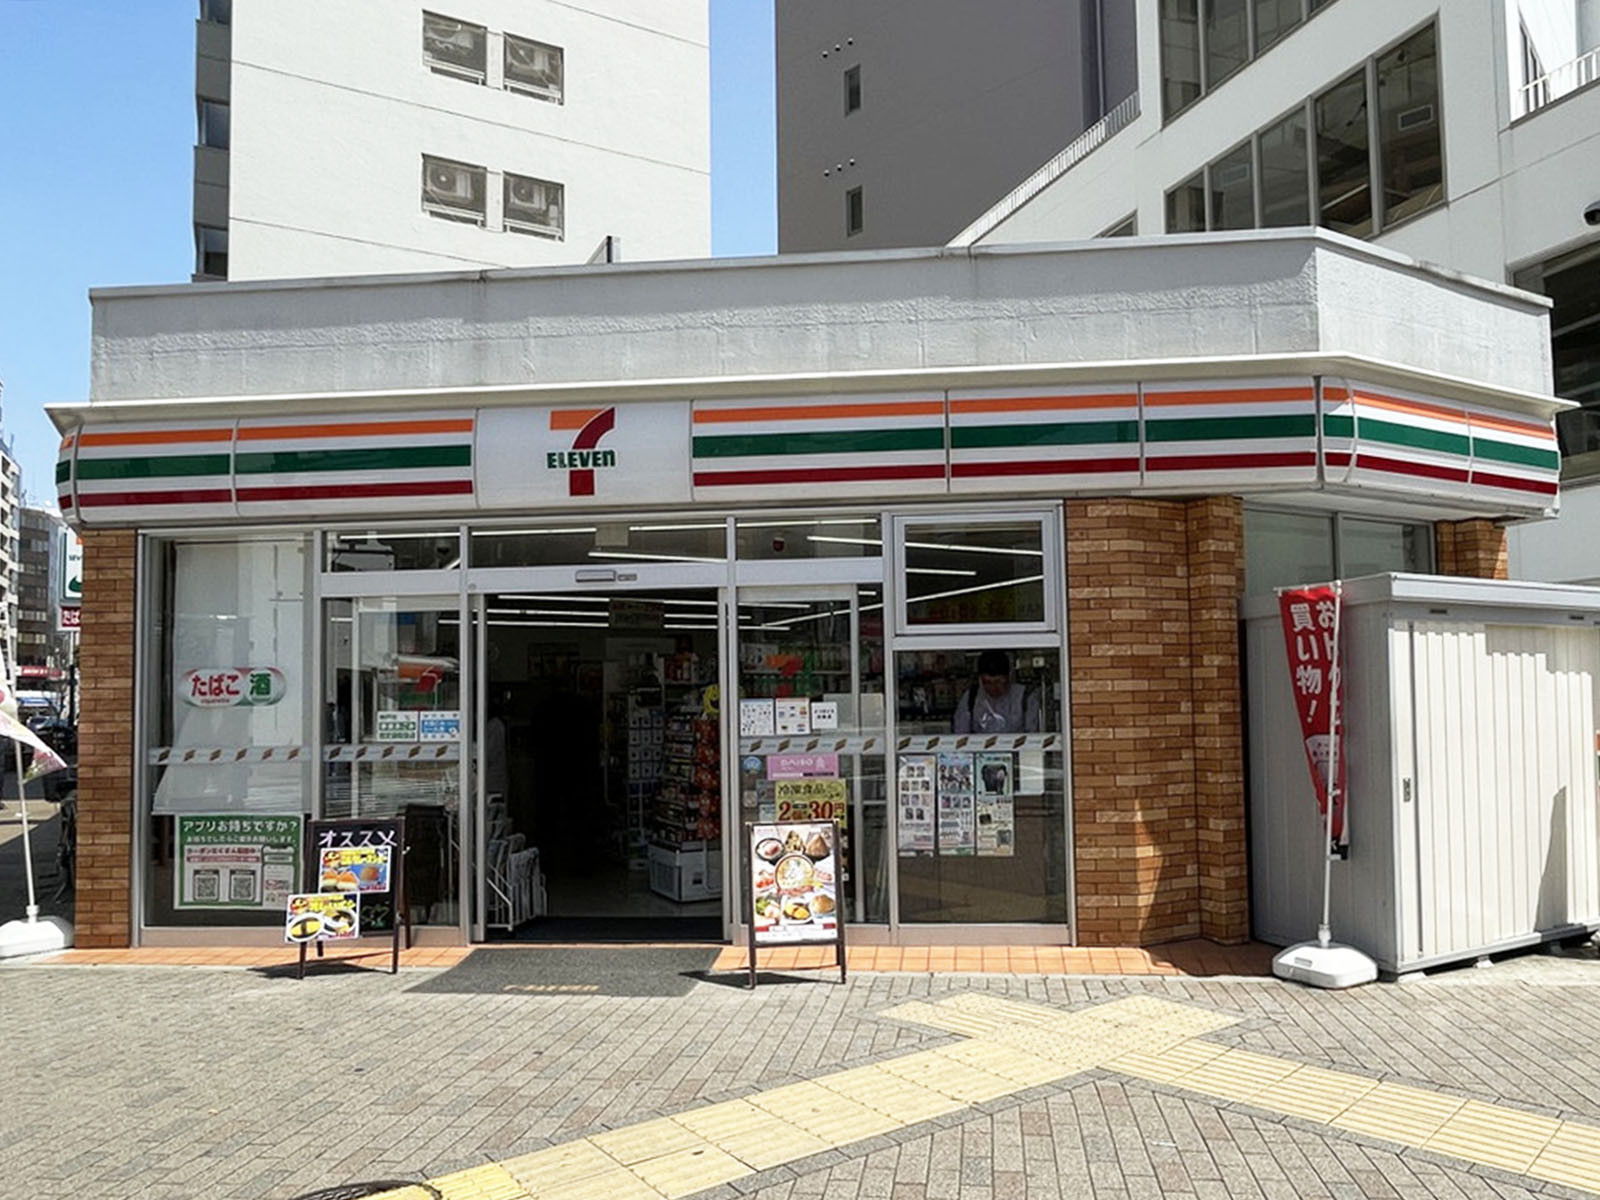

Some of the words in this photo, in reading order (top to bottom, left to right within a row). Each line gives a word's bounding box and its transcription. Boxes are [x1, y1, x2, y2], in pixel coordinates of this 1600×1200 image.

[191, 673, 240, 697] たばこ
[249, 673, 272, 696] 酒
[318, 830, 398, 848] オススメ
